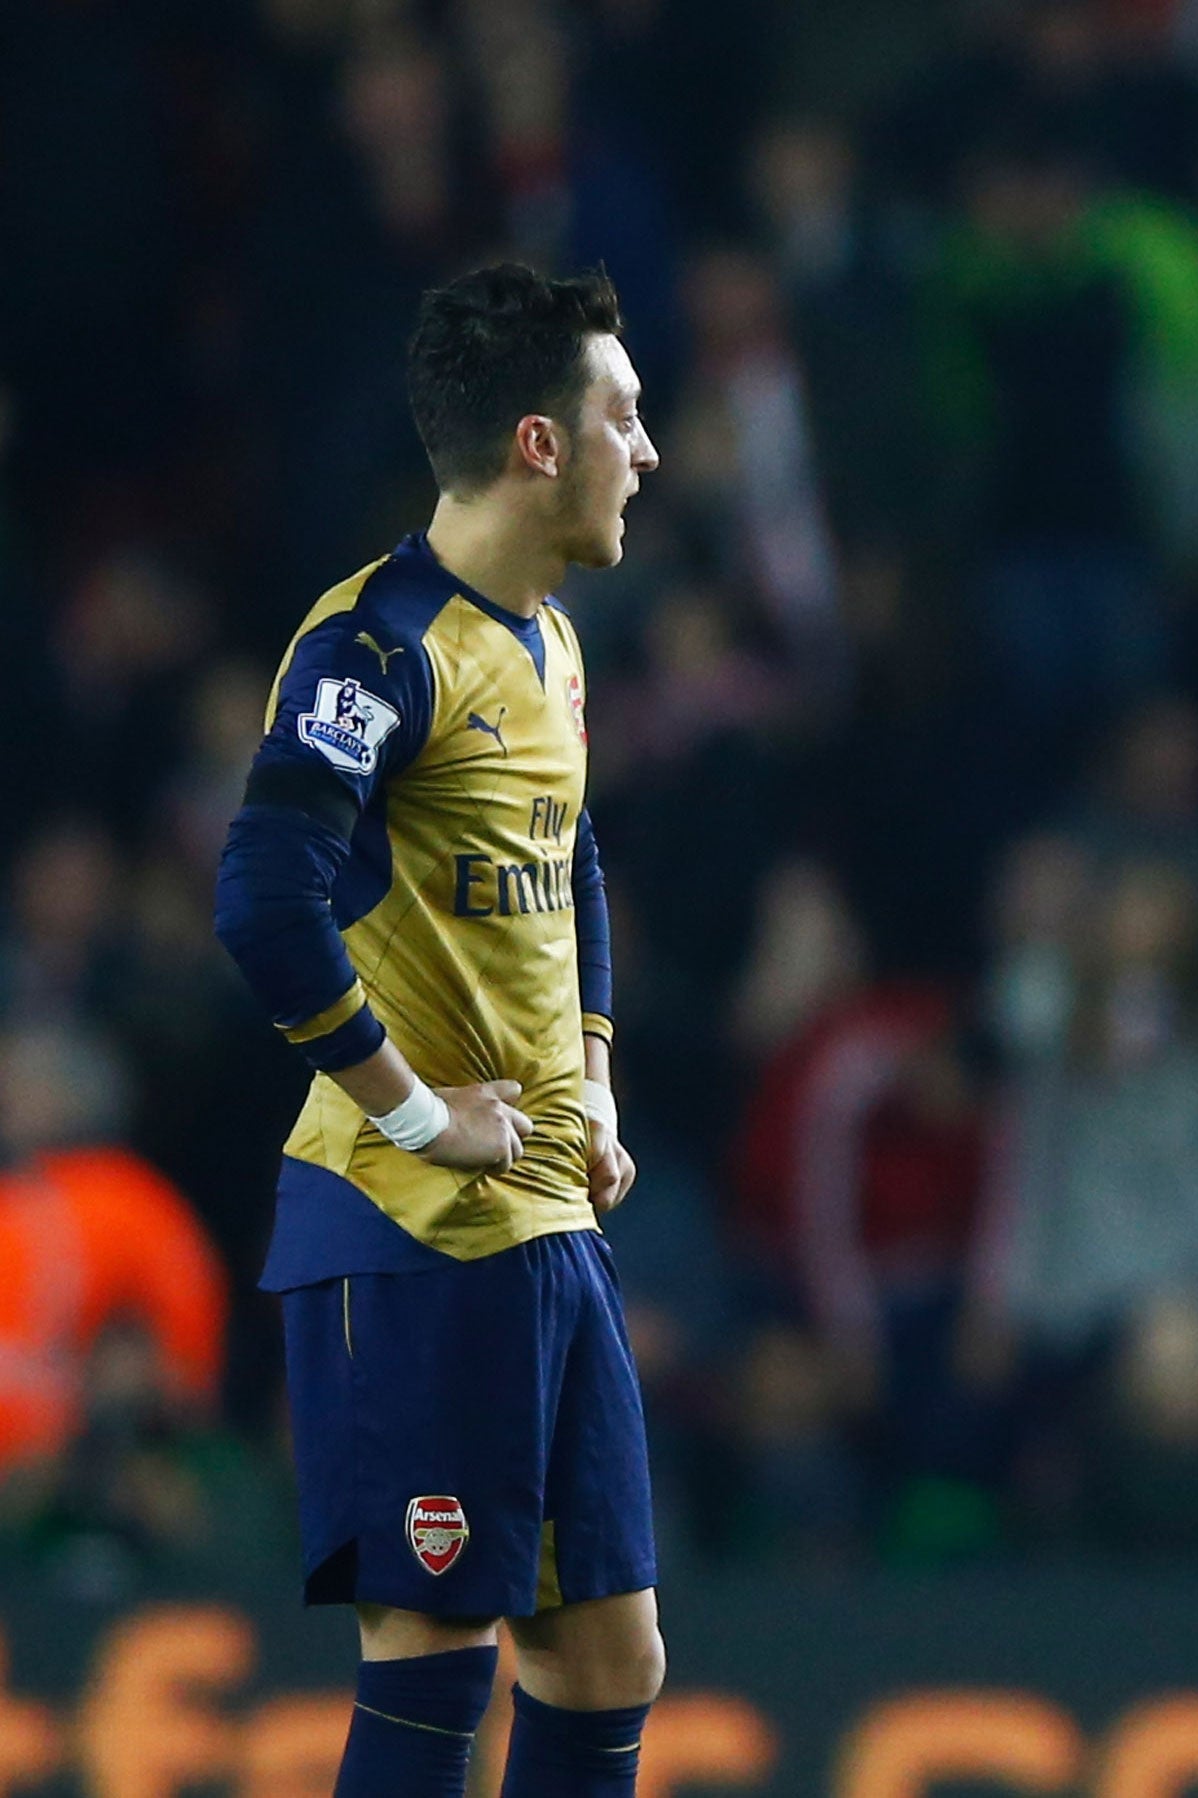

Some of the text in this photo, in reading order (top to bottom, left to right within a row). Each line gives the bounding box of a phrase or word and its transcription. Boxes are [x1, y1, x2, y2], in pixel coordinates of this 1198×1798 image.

[310, 722, 363, 753] BARCLAYS
[529, 796, 568, 847] Fly
[453, 847, 574, 918] Emir
[414, 1507, 464, 1523] Arsenal
